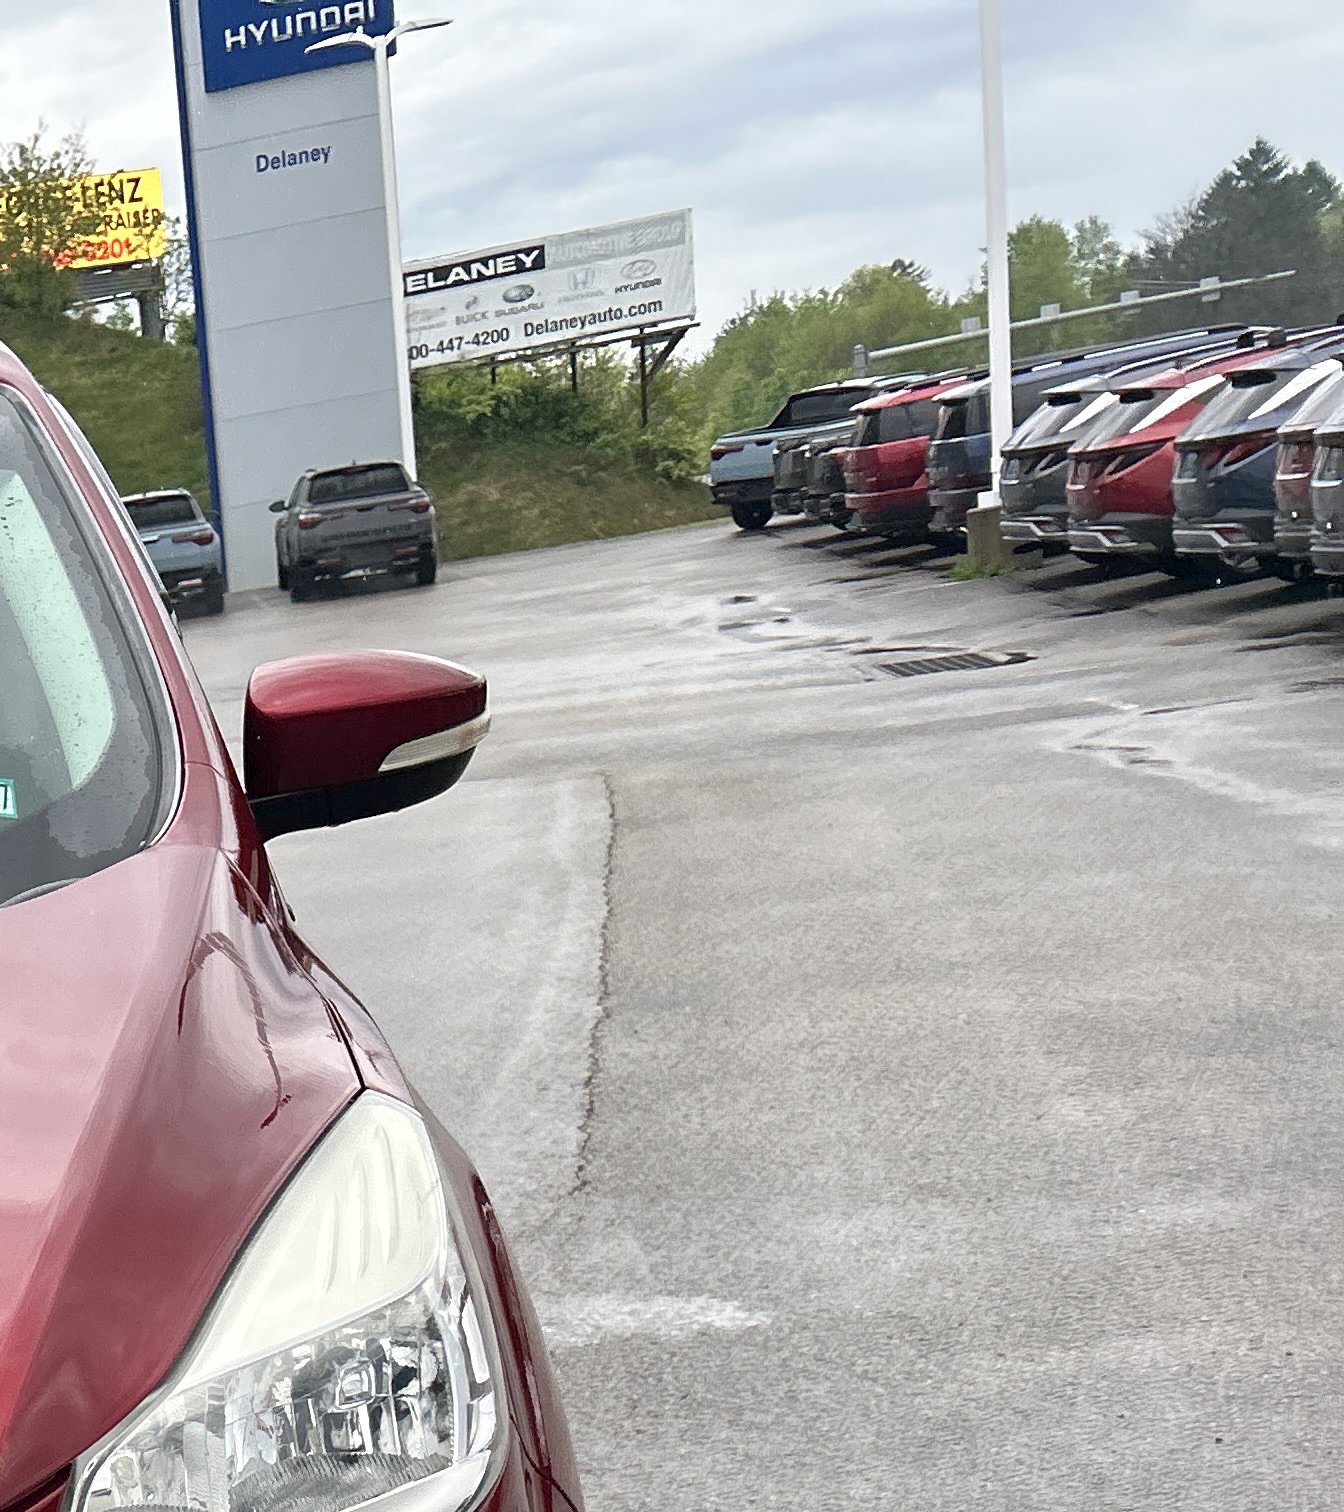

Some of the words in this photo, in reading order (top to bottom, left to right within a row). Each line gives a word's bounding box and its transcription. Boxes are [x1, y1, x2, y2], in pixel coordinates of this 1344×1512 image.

[224, 0, 375, 52] HYUNDAI
[255, 146, 332, 173] Delaney
[405, 248, 541, 293] ELANEY
[408, 327, 510, 360] 00-447-4200
[523, 299, 663, 337] Delaneyauto.com
[455, 311, 489, 326] BUICK
